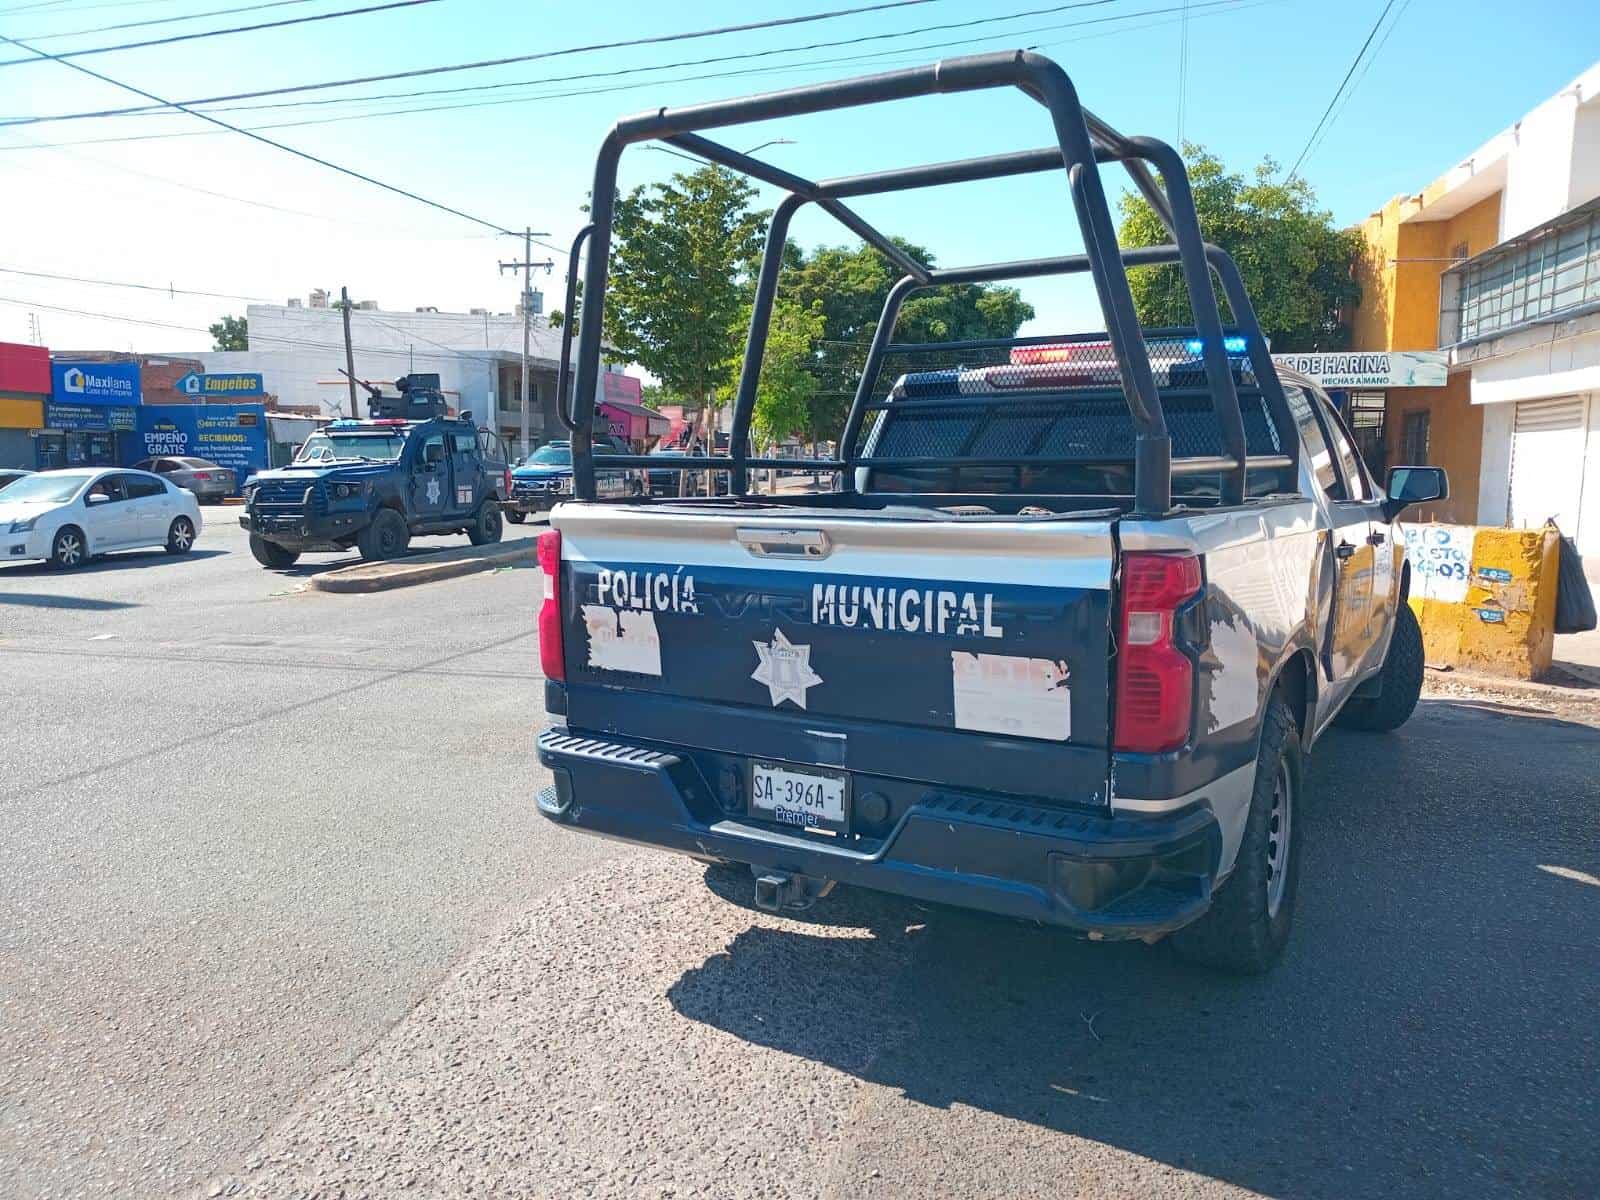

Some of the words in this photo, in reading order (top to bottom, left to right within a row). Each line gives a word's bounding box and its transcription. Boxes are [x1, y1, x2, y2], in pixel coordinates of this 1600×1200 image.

[1297, 356, 1321, 374] DE
[1322, 355, 1391, 375] HARINA
[85, 374, 132, 390] Maxilana
[204, 377, 257, 392] Empeños
[1322, 377, 1355, 385] HECHAS
[1356, 377, 1362, 385] A
[1363, 377, 1390, 385] MANO
[144, 430, 188, 444] EMPEÑO
[147, 444, 185, 455] GRATIS
[597, 566, 699, 614] POLICÍA
[811, 583, 1004, 639] MUNICIPAL
[754, 775, 844, 812] SA-396A-1
[775, 806, 818, 826] Premier
